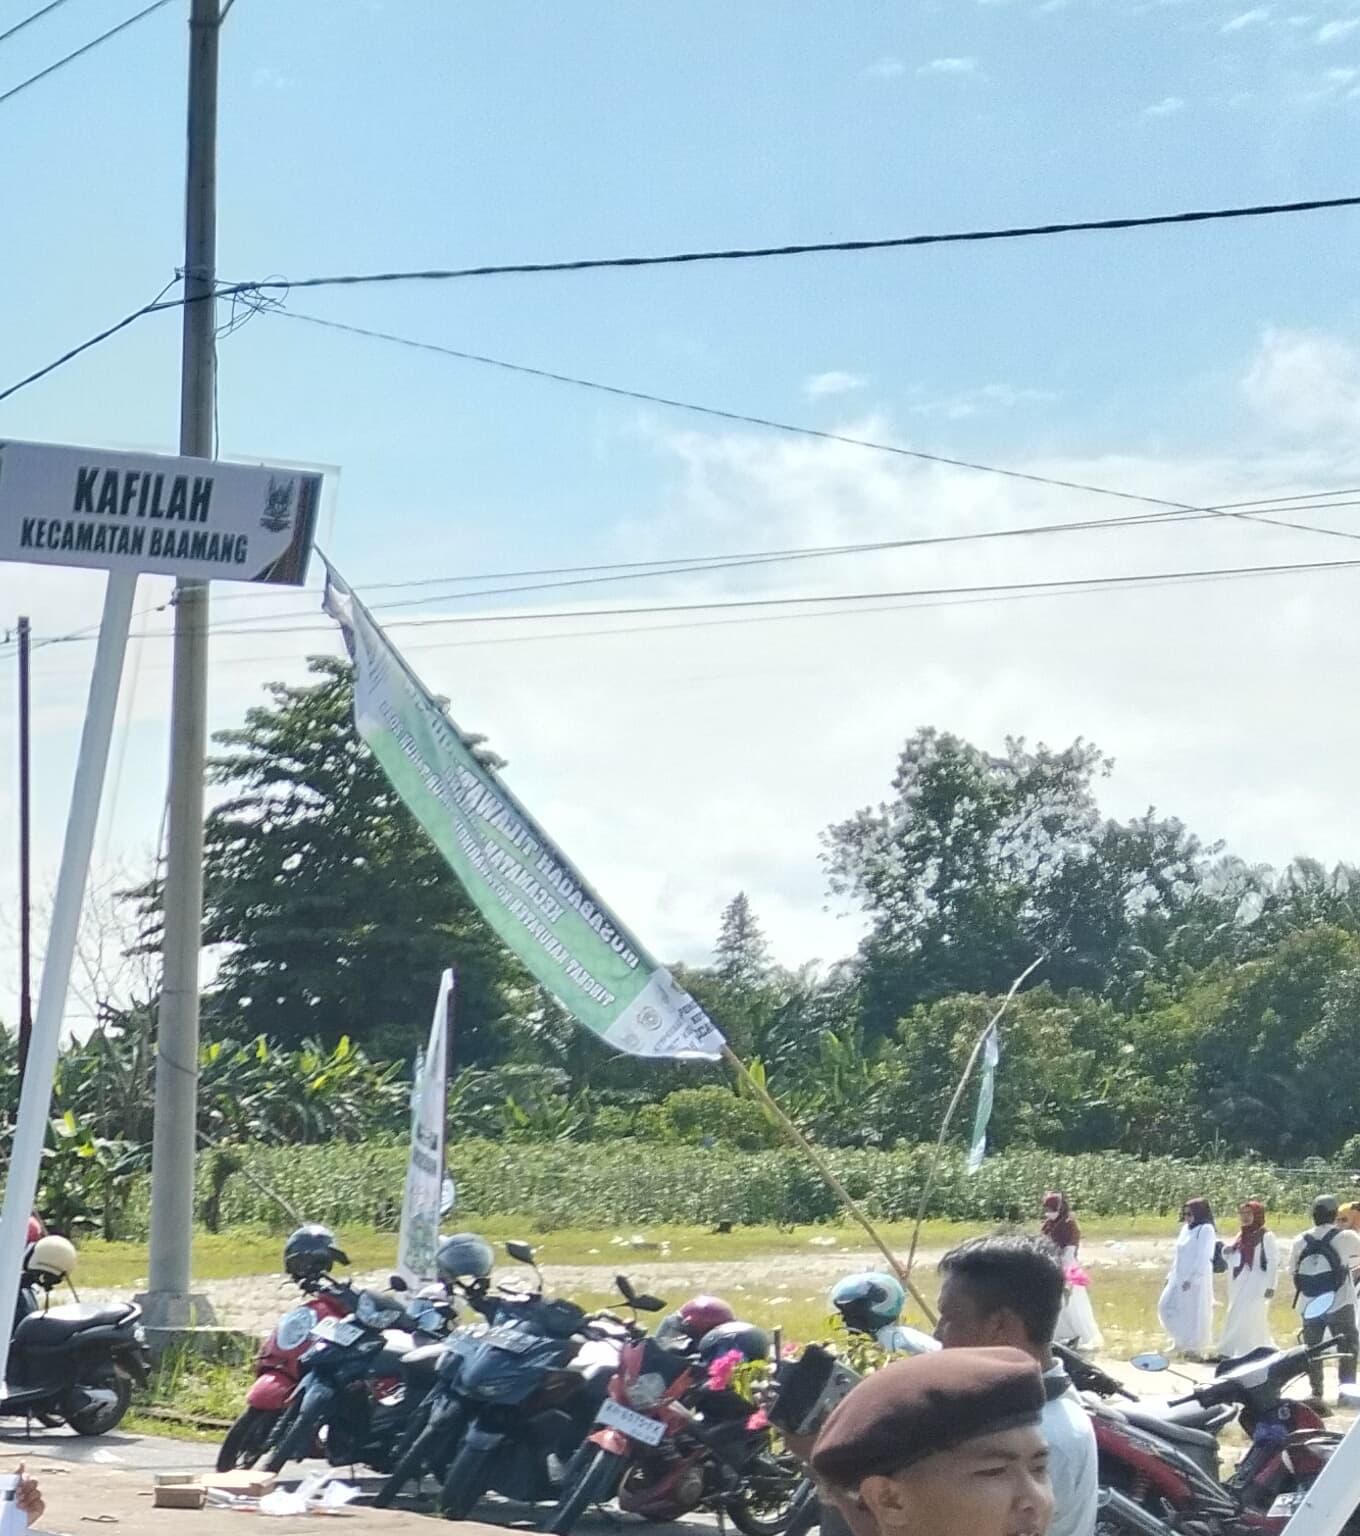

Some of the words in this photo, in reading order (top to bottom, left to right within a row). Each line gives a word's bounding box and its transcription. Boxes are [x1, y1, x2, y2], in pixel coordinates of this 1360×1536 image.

[73, 466, 214, 523] KAFILAH
[20, 517, 146, 557] KECAMATAN
[148, 530, 248, 564] BAAMANG
